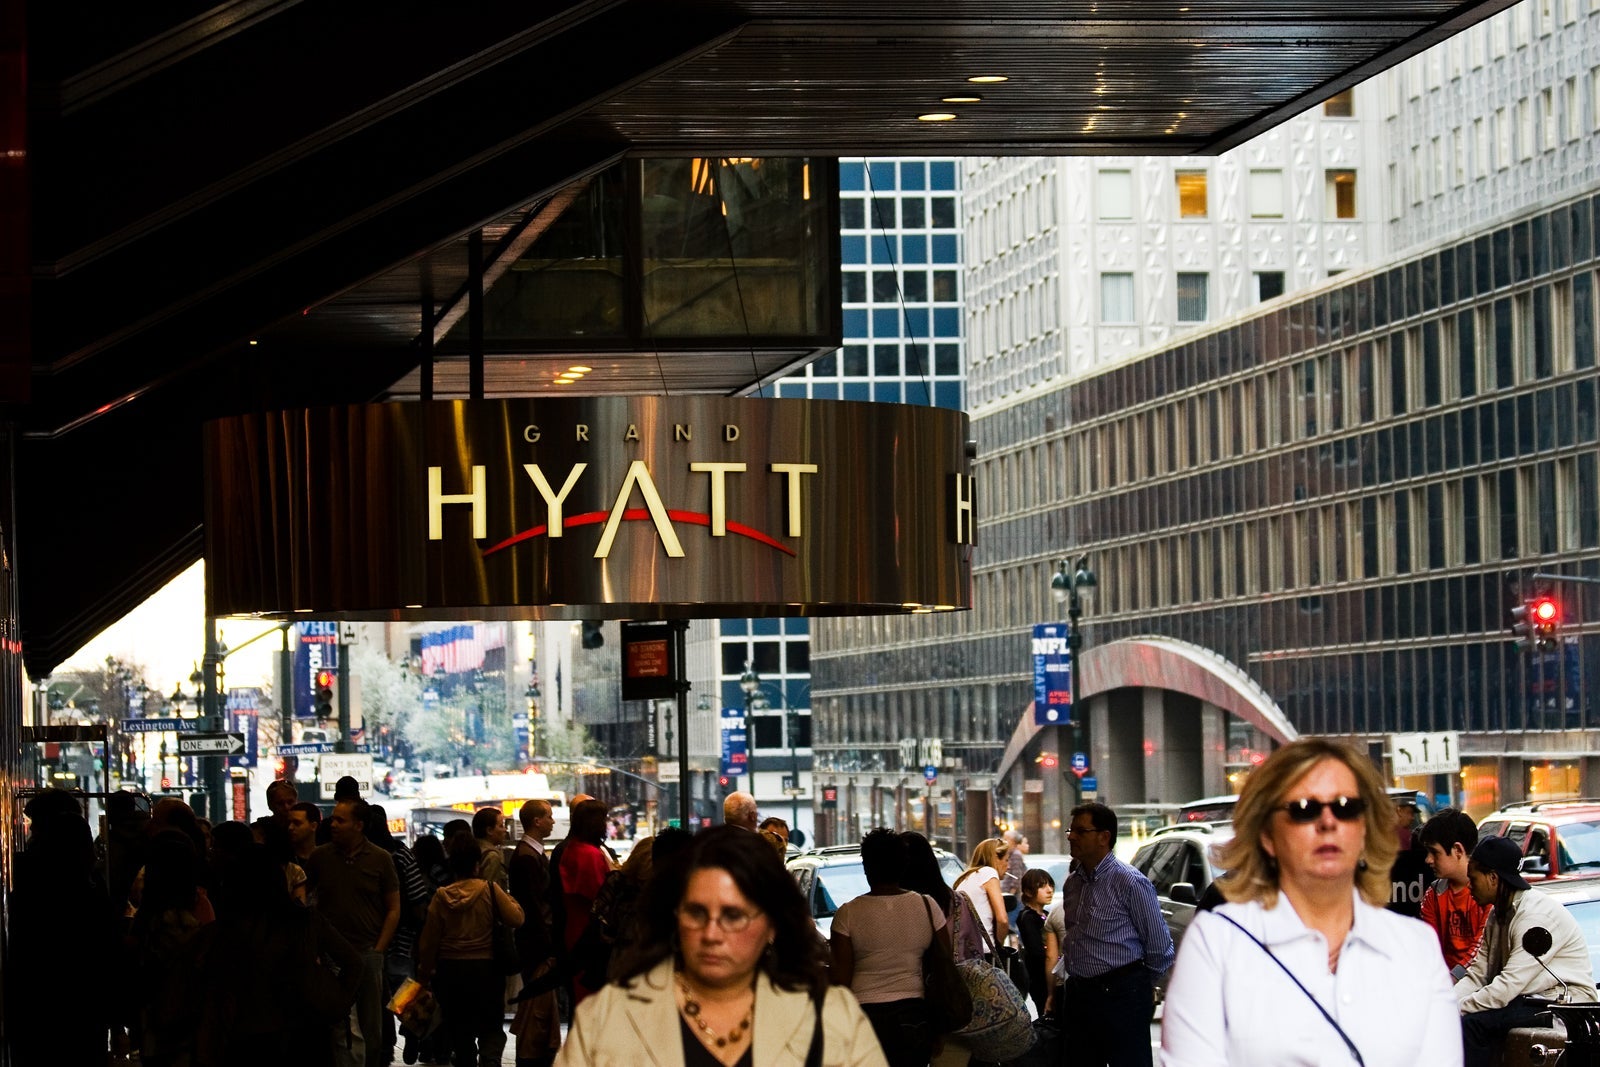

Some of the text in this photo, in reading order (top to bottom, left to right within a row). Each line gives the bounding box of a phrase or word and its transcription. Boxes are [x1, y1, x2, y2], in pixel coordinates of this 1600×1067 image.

[523, 424, 741, 443] GRAND
[428, 460, 818, 558] HYATT
[1032, 638, 1070, 655] NFL
[1036, 656, 1046, 704] DRAFT
[123, 720, 197, 732] Lexington Ave
[720, 717, 746, 729] NFL
[183, 740, 236, 750] ONE WAY
[277, 746, 317, 755] Lexington
[320, 744, 335, 754] Ave
[1386, 874, 1425, 903] nd
